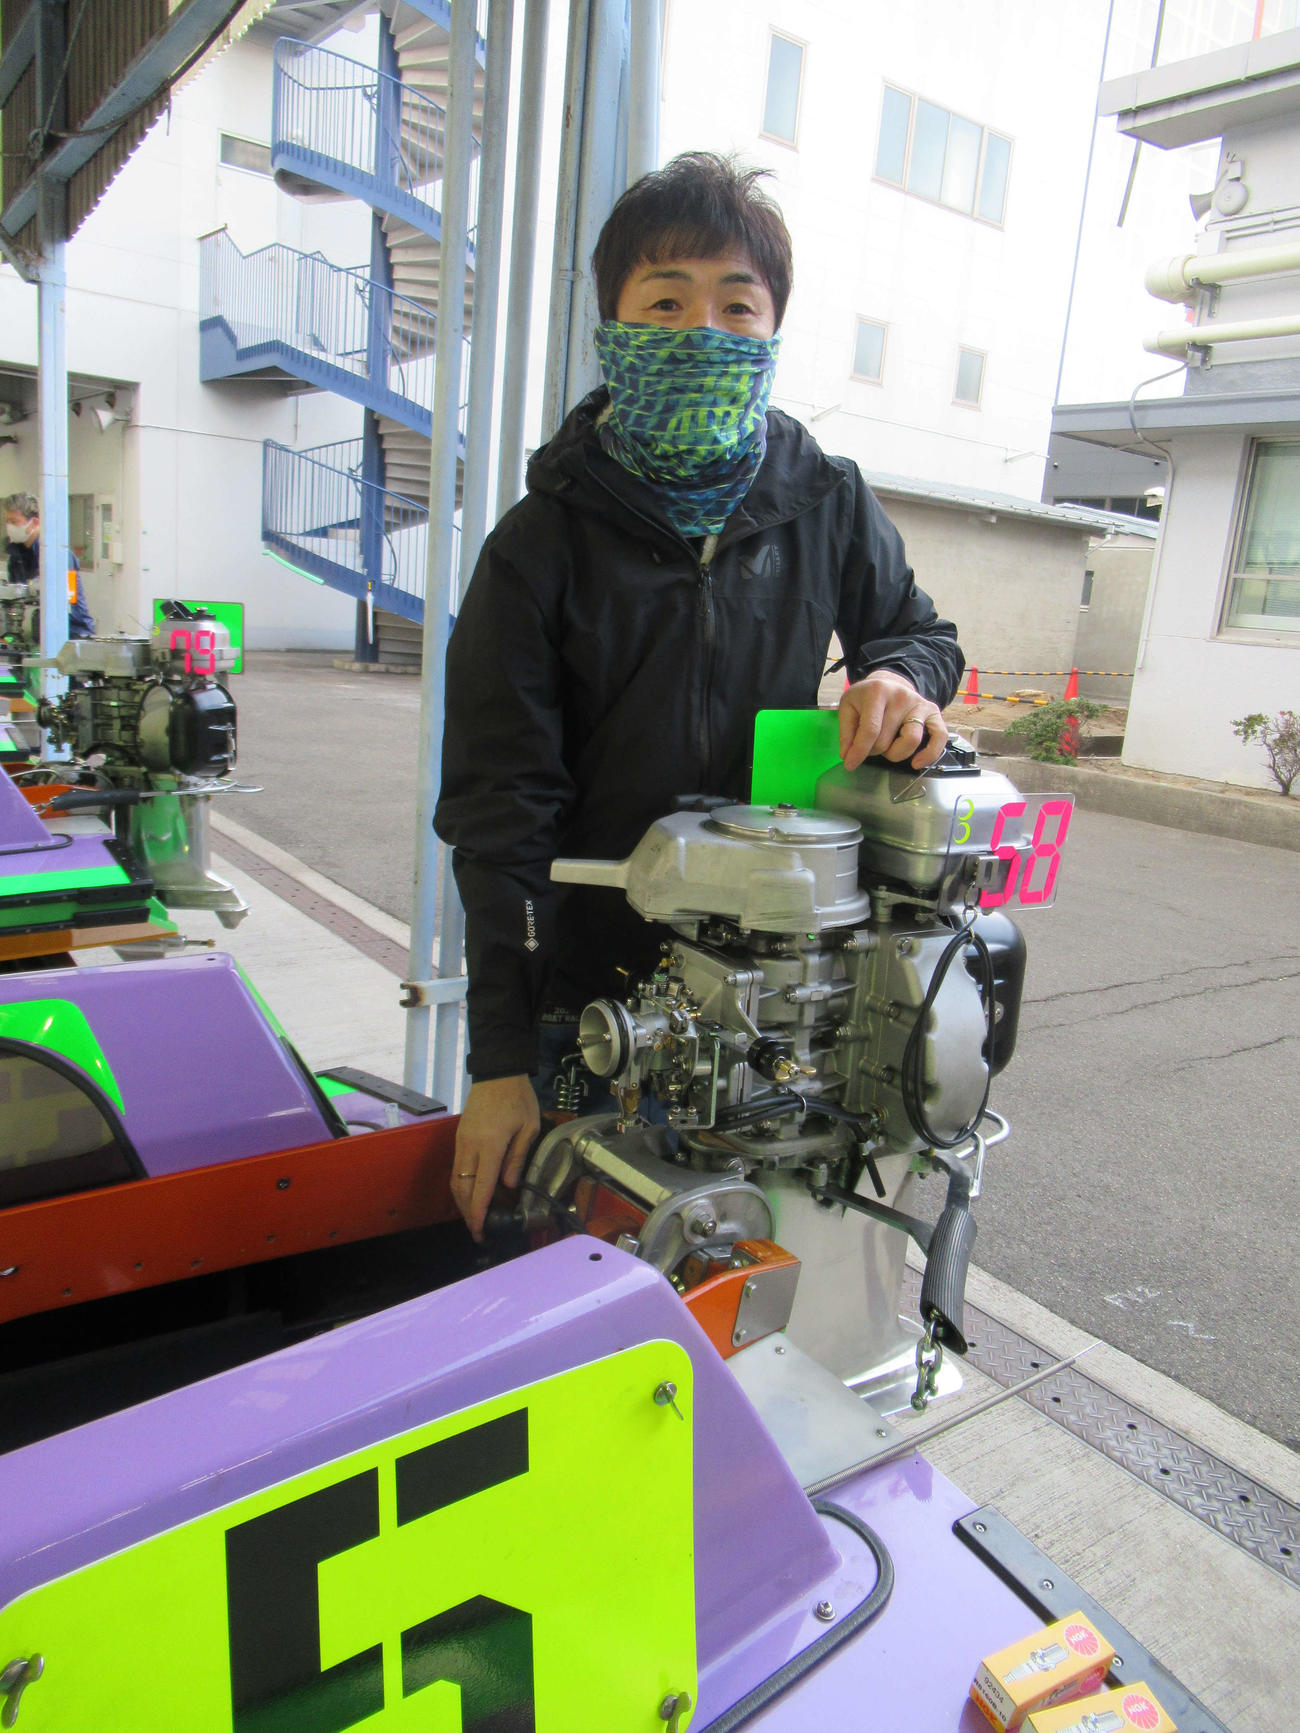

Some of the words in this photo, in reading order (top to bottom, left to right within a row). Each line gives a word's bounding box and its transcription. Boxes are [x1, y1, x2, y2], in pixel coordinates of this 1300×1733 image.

[169, 629, 216, 676] 79
[525, 900, 536, 938] GORE-TEX
[1070, 1630, 1089, 1644] NGK
[1128, 1702, 1149, 1714] NGK
